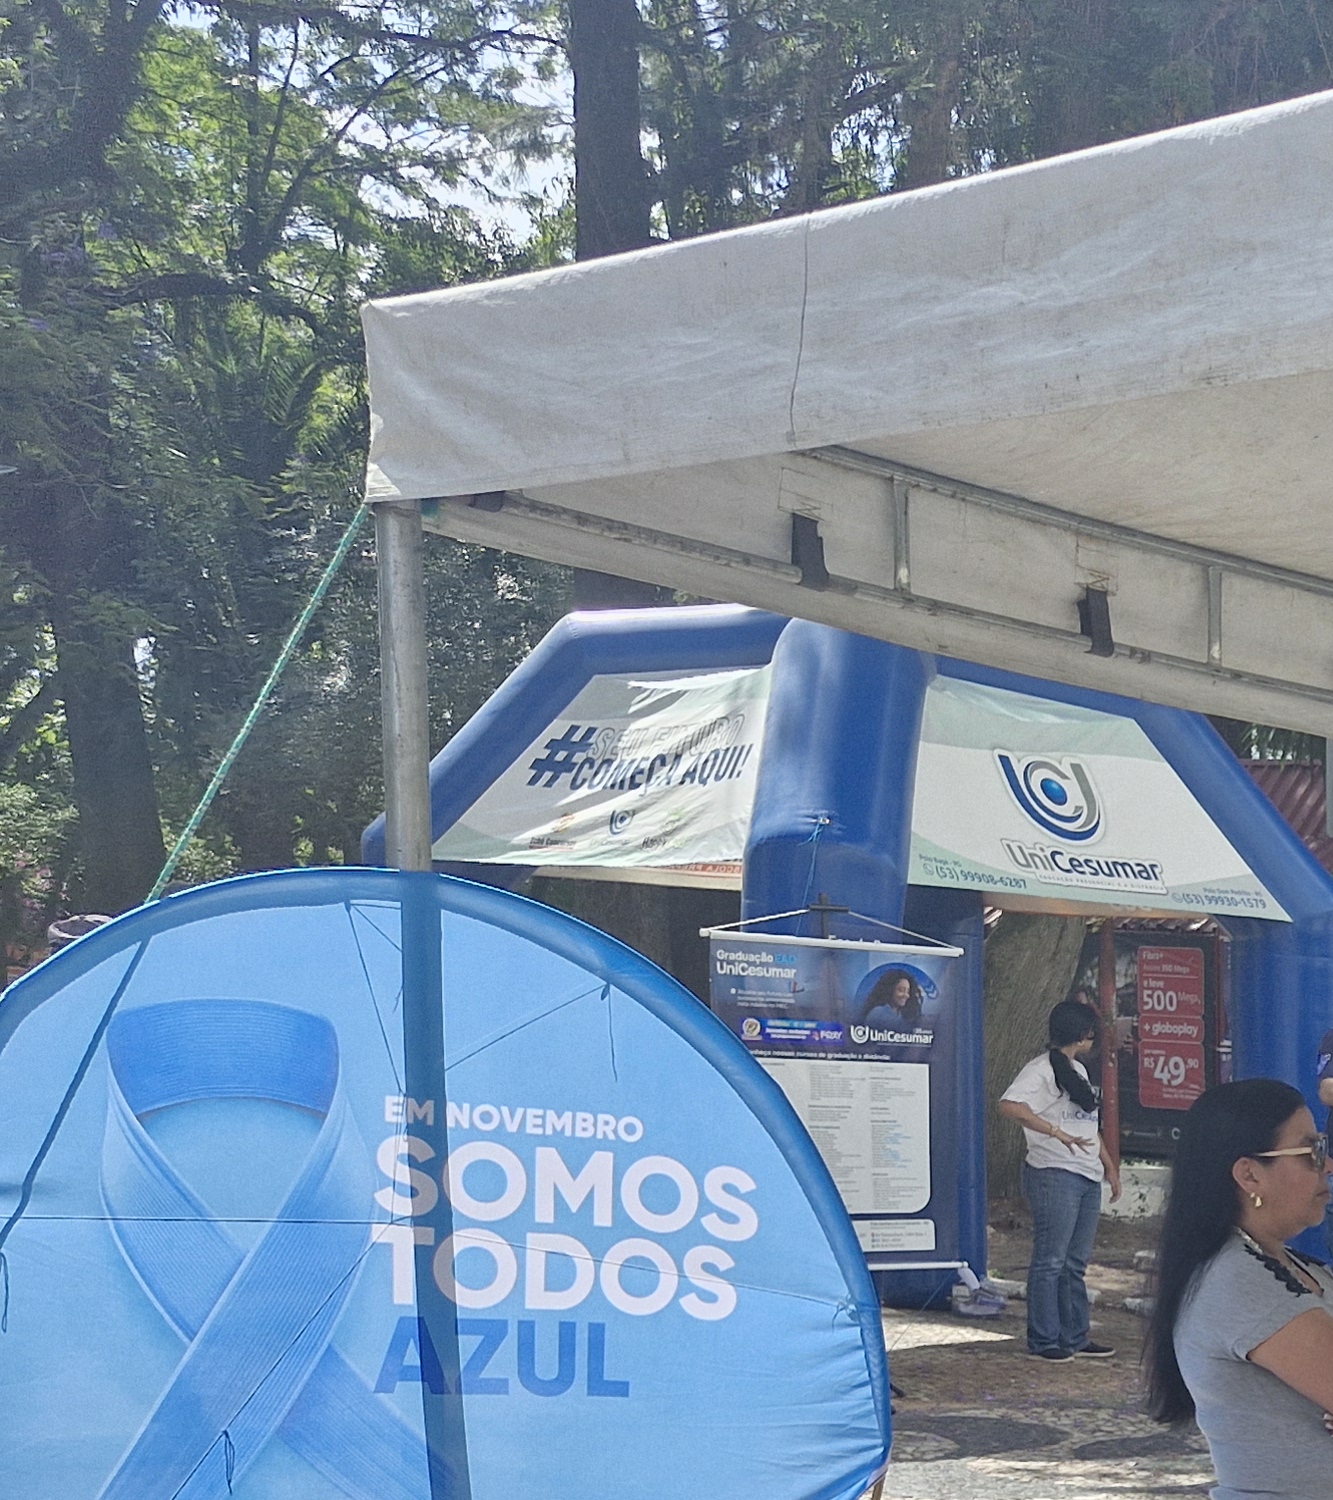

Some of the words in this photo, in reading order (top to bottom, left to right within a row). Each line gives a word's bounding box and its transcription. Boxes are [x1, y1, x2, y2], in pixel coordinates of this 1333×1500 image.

[569, 750, 684, 797] COMEÇA
[679, 744, 754, 786] AQUI!
[1005, 842, 1160, 882] UniCesumar
[935, 865, 960, 882] (53)
[960, 869, 1027, 889] 99908-6287
[1182, 893, 1204, 905] (53)
[1205, 894, 1267, 909] 99930-1579
[716, 949, 774, 965] Graduação
[716, 963, 797, 978] UniCesumar
[1149, 978, 1164, 988] leve
[1143, 989, 1177, 1011] 500
[870, 1030, 934, 1044] UniCesumar
[1152, 1022, 1198, 1037] globoplay
[384, 1095, 434, 1126] EM
[448, 1101, 644, 1143] NOVEMBRO
[373, 1134, 760, 1242] SOMOS
[370, 1223, 738, 1321] TODOS
[372, 1315, 630, 1398] AZUL
